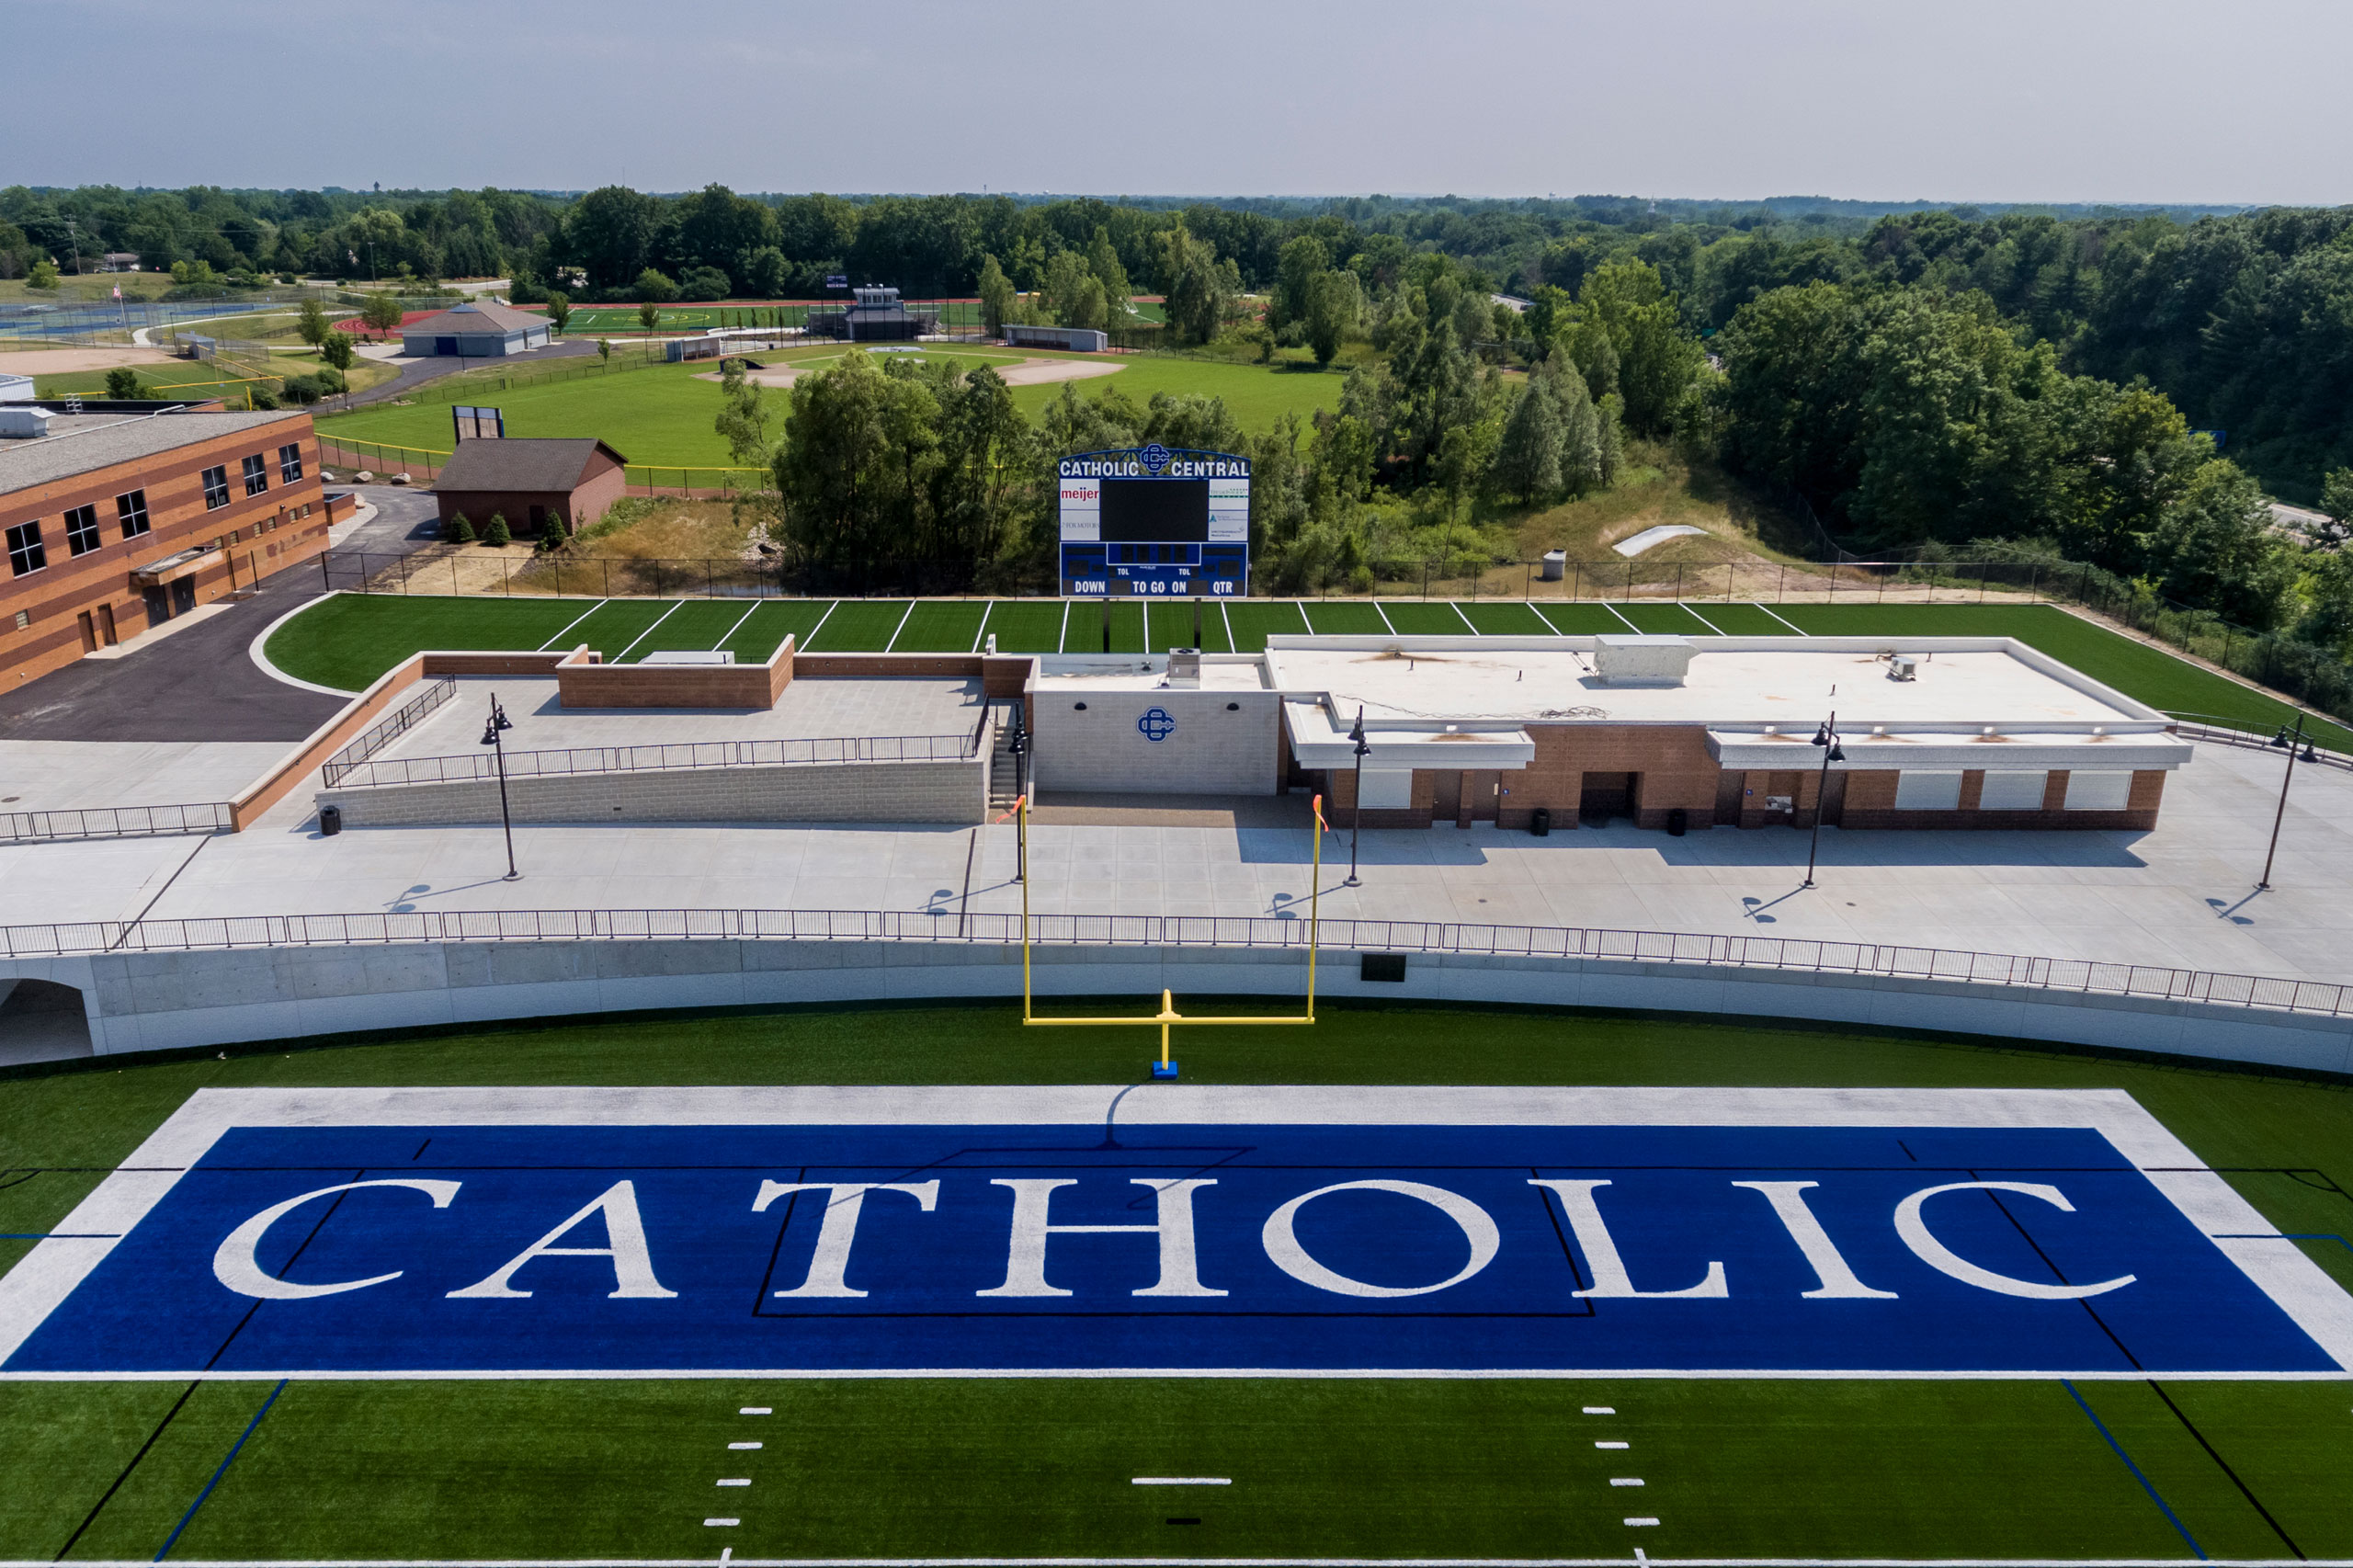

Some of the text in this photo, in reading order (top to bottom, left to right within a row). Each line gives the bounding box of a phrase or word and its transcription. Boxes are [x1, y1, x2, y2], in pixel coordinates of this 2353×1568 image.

[1060, 461, 1249, 477] CATHOLIC CENTRAL
[1061, 487, 1099, 502] meijer
[1074, 581, 1106, 593] DOWN
[1132, 581, 1187, 593] TO GO ON
[1212, 581, 1233, 595] QTR
[212, 1177, 2137, 1300] CATHOLIC
